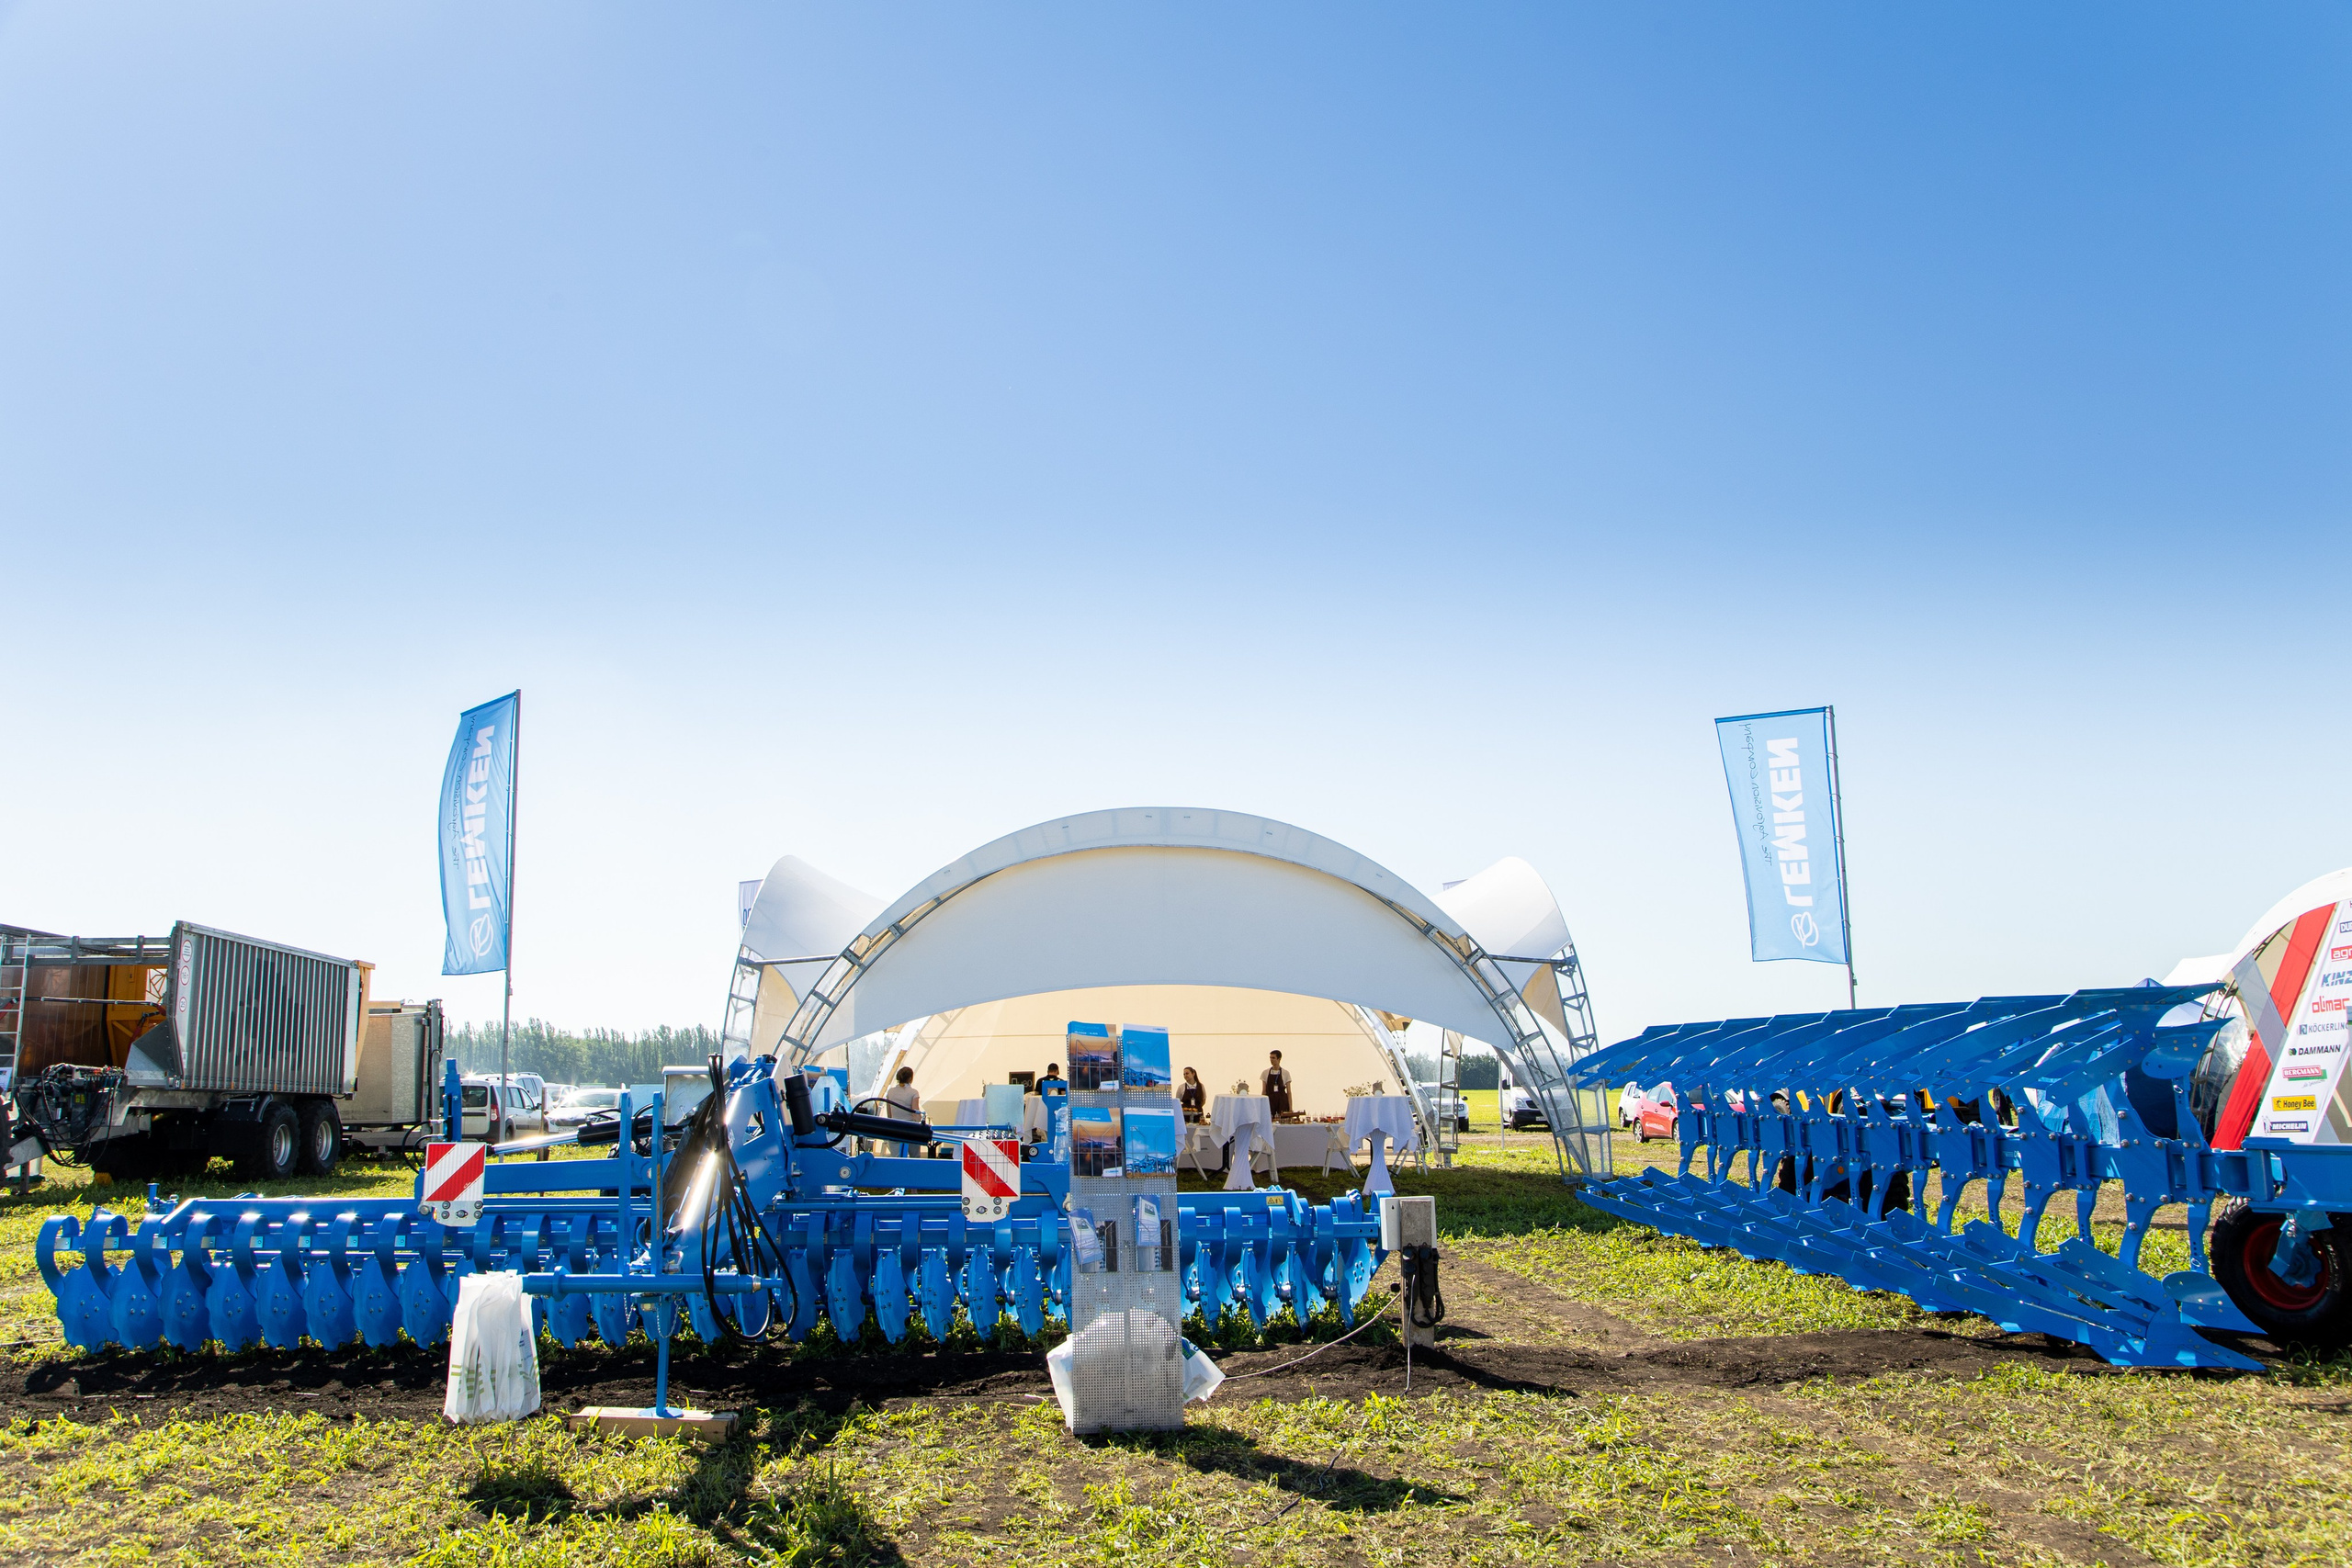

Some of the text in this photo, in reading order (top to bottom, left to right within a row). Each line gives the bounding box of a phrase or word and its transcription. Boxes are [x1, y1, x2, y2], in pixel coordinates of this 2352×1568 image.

[2298, 1044, 2341, 1055] DAMMANN
[2284, 1066, 2320, 1076] BERGMANN
[2283, 1099, 2315, 1110] Honey Bee
